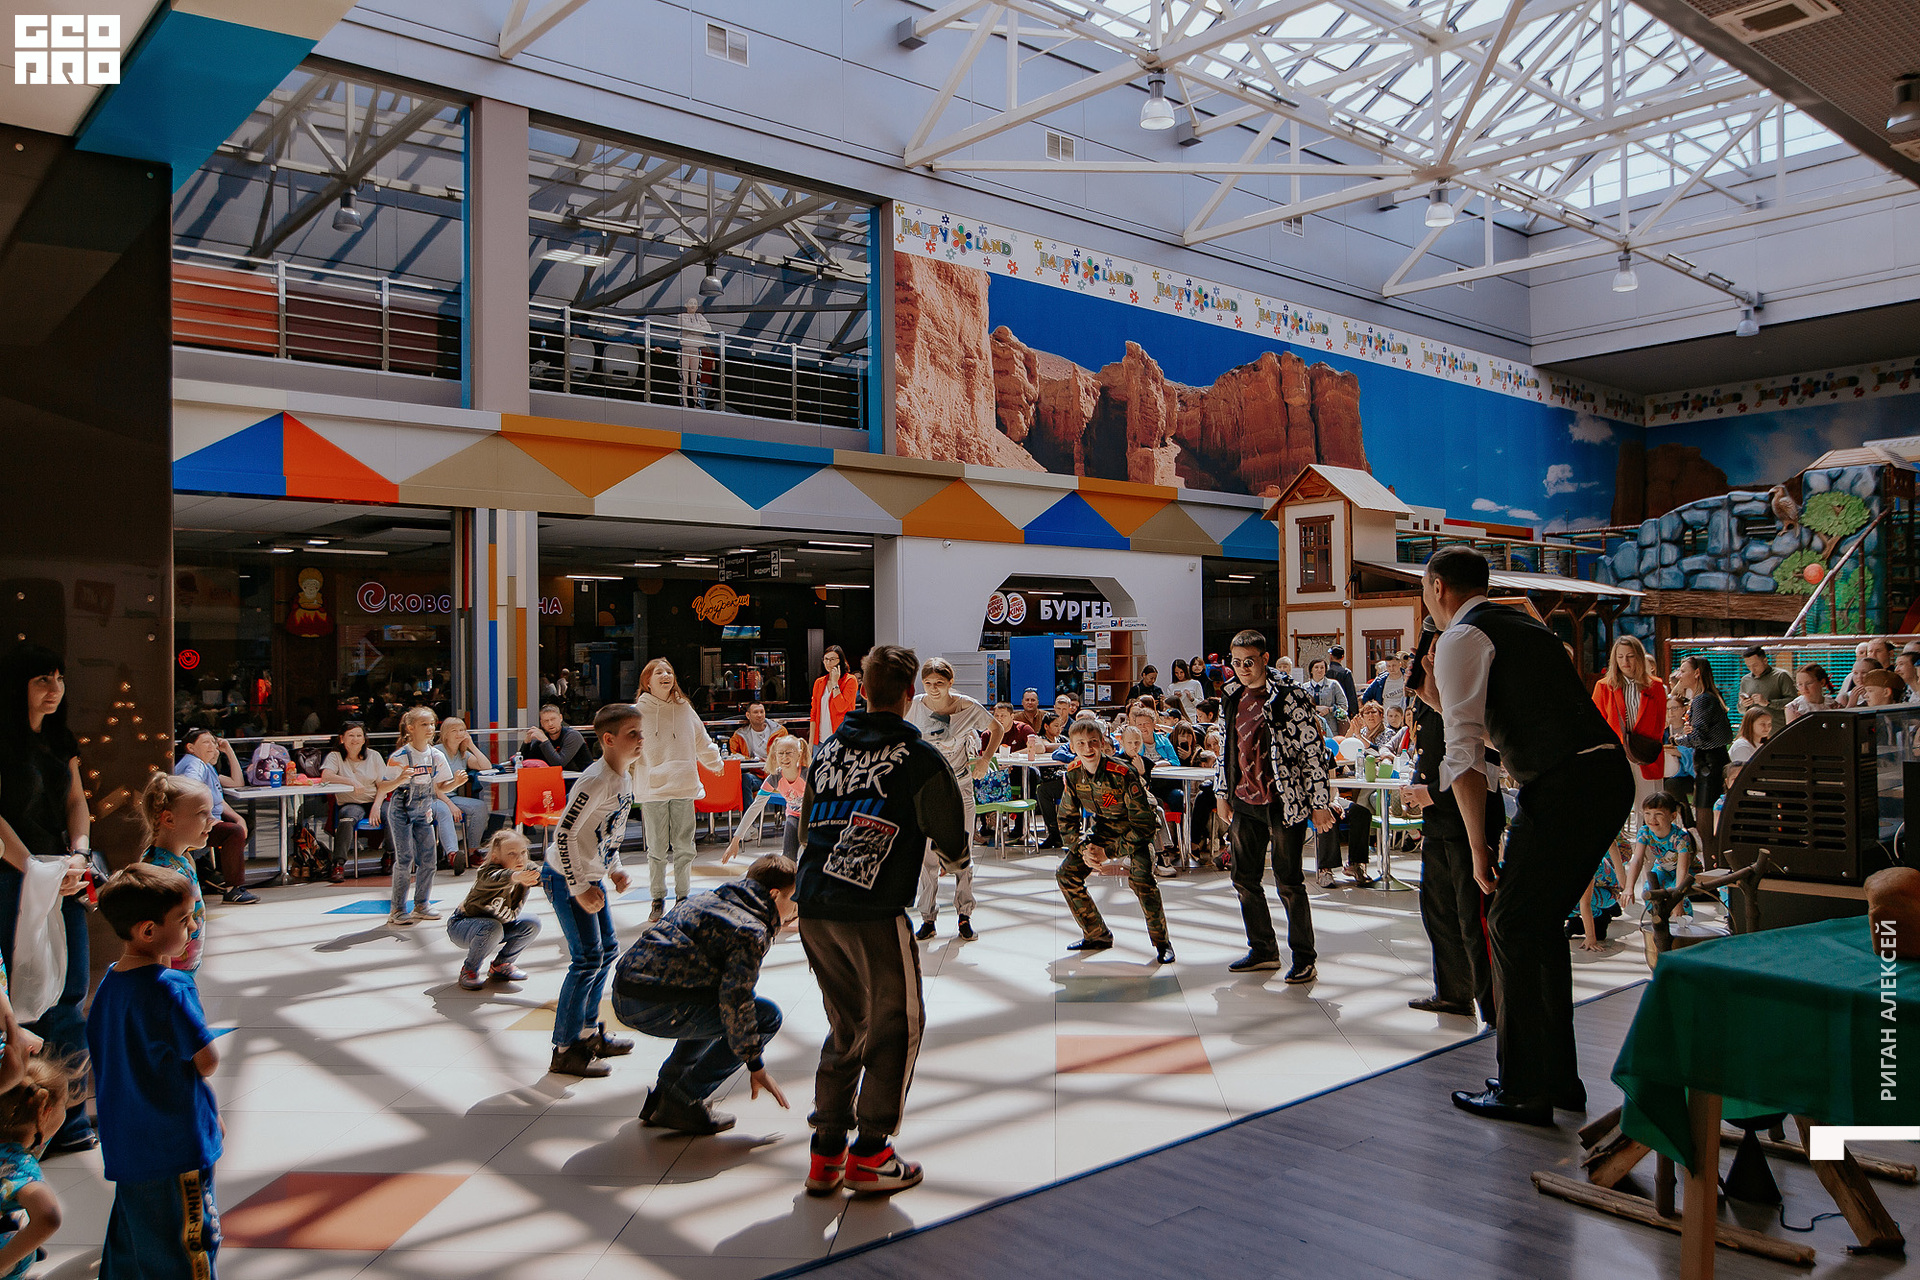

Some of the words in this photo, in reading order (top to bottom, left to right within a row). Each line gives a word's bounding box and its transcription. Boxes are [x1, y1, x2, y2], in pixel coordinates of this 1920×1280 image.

[901, 217, 948, 244] HAPPY
[973, 235, 1011, 257] LAND
[1039, 251, 1079, 276] HAPPY
[1101, 268, 1133, 287] LAND
[1157, 281, 1191, 303] HAPPY
[1210, 295, 1238, 312] LAND
[1258, 307, 1288, 327] HAPPY
[1302, 319, 1327, 335] LAND
[1346, 330, 1372, 348] HAPPY
[1387, 341, 1408, 354] LAND
[1424, 350, 1446, 366] HAPPY
[1459, 360, 1478, 373] LAND
[815, 762, 894, 798] POWER
[560, 791, 590, 830] WANTED
[854, 817, 893, 834] SONIC
[557, 831, 577, 887] EXPLORERS
[184, 1178, 202, 1252] OFF-WHITE
